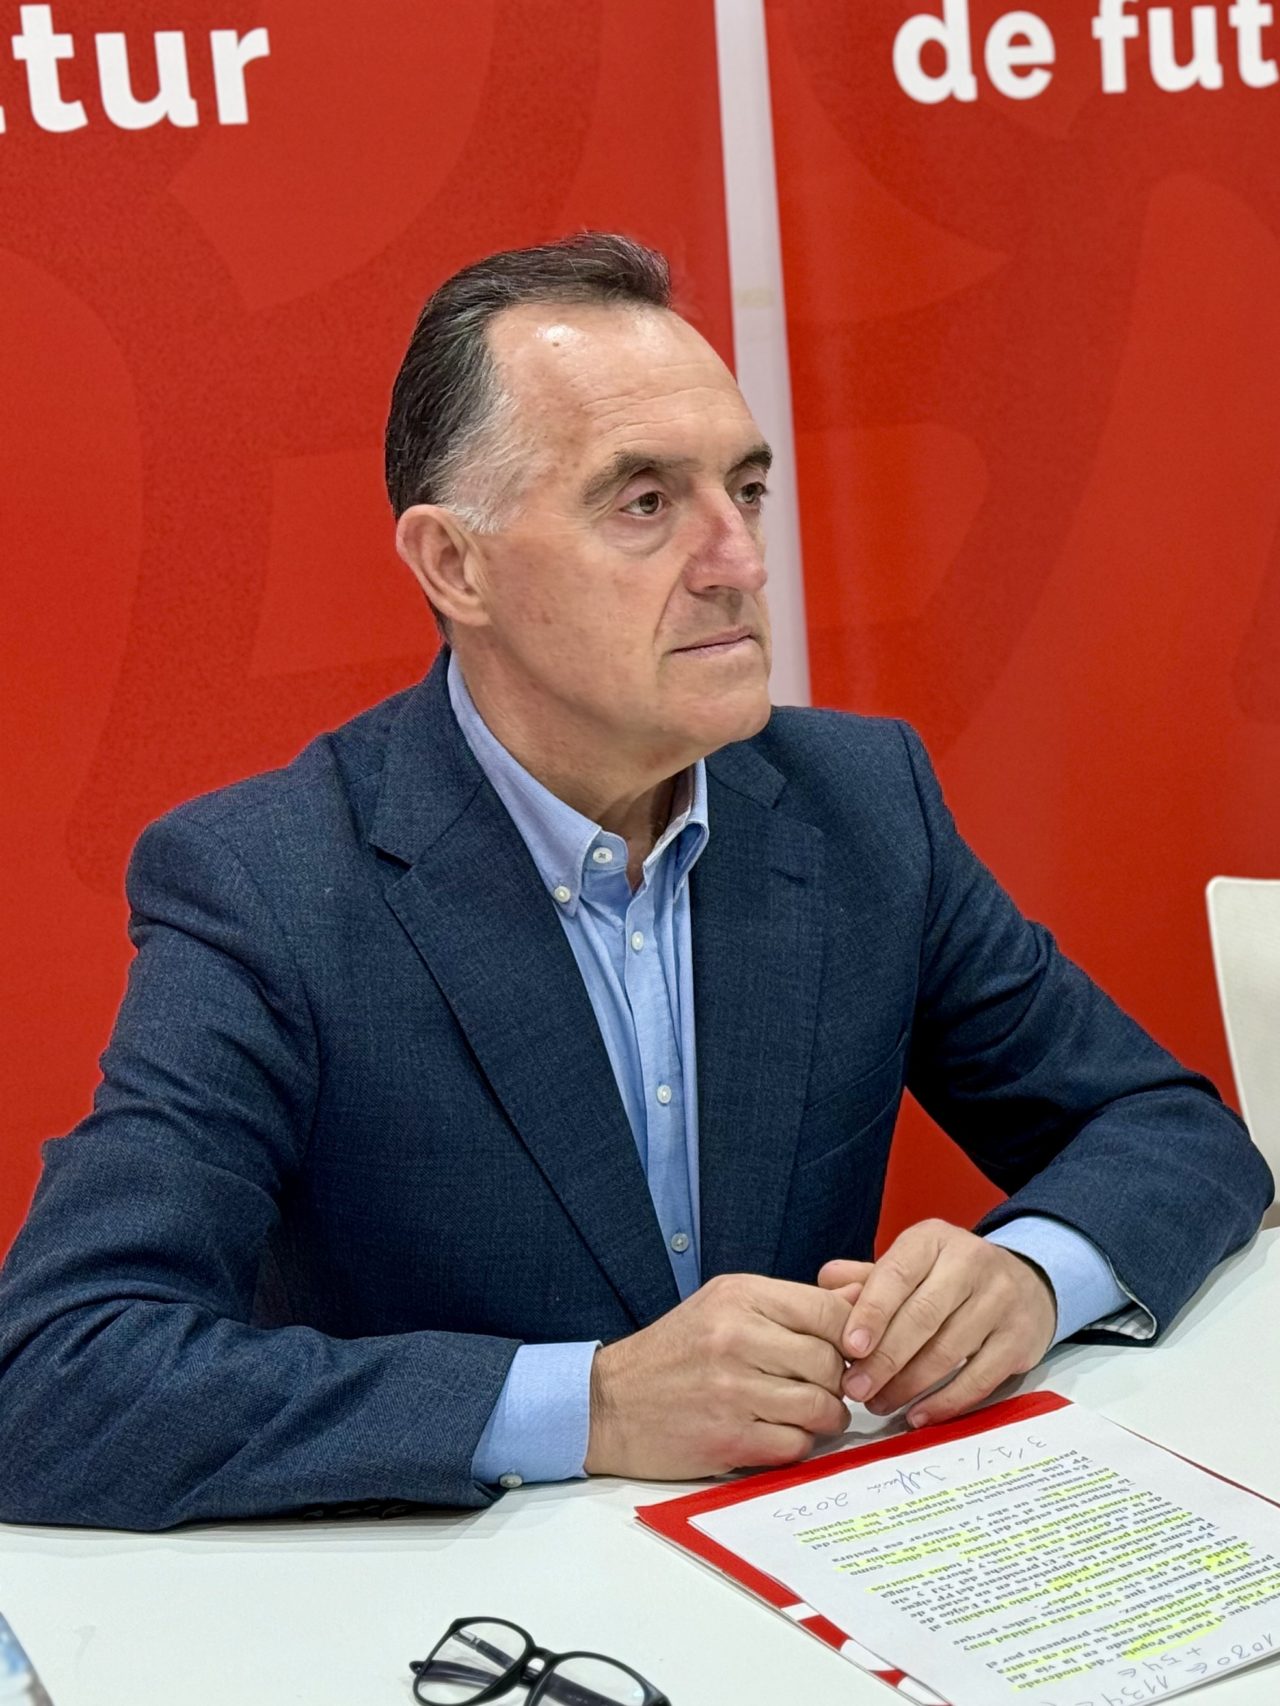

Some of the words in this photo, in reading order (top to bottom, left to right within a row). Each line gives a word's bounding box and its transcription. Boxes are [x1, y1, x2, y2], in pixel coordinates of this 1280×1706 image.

[892, 0, 1056, 104] de
[0, 4, 271, 133] tur
[1063, 1471, 1120, 1492] pensiones
[1116, 1477, 1134, 1485] lo
[1032, 1490, 1062, 1502] hace
[1039, 1482, 1113, 1508] demostraron
[1079, 1487, 1130, 1504] Siempre
[1097, 1490, 1153, 1510] fuéramos
[773, 1492, 849, 1522] 2023
[986, 1507, 1009, 1517] año
[1012, 1500, 1030, 1509] un
[1054, 1502, 1079, 1512] han
[987, 1513, 1019, 1526] votar
[1013, 1510, 1052, 1526] estado
[1041, 1507, 1096, 1529] culpables
[1064, 1506, 1128, 1530] ciudadanía
[1132, 1506, 1183, 1525] teniendo
[1132, 1511, 1192, 1534] crispación
[991, 1524, 1012, 1534] del
[1066, 1520, 1112, 1539] derrota
[1169, 1516, 1205, 1532] haber
[1197, 1522, 1219, 1532] PP
[909, 1525, 955, 1542] reiterar
[921, 1532, 962, 1547] contra
[963, 1531, 992, 1543] lado
[1028, 1528, 1061, 1543] como
[1069, 1523, 1128, 1546] pesadillas
[1110, 1529, 1166, 1551] instalado
[1159, 1529, 1193, 1543] como
[1213, 1534, 1238, 1547] está
[883, 1540, 904, 1549] esa
[924, 1545, 944, 1554] las
[977, 1545, 1011, 1559] todas
[1029, 1542, 1049, 1551] las
[1041, 1545, 1065, 1556] con
[1135, 1541, 1184, 1562] decisión
[1204, 1540, 1252, 1559] alejada
[831, 1546, 879, 1562] postura
[865, 1551, 896, 1563] subir
[1077, 1553, 1097, 1562] los
[1092, 1541, 1157, 1567] alternativa
[1170, 1543, 1213, 1562] cegado
[1233, 1550, 1251, 1560] El
[839, 1560, 860, 1569] las
[849, 1563, 884, 1575] como
[927, 1561, 963, 1574] todos
[982, 1561, 1020, 1576] noche
[1212, 1553, 1274, 1580] presidente
[1216, 1557, 1234, 1567] PP
[936, 1566, 974, 1581] ahora
[976, 1562, 1040, 1587] presidente
[1013, 1559, 1075, 1584] populares
[1043, 1564, 1090, 1584] política
[1075, 1566, 1115, 1583] contra
[1093, 1565, 1154, 1590] fanatismo
[1144, 1570, 1168, 1581] que
[1148, 1564, 1212, 1590] demuestra
[1222, 1564, 1271, 1586] paquete
[870, 1572, 925, 1592] nosotros
[957, 1575, 978, 1585] del
[1053, 1581, 1073, 1592] del
[1115, 1580, 1142, 1592] vive
[1174, 1577, 1212, 1594] Pedro
[879, 1584, 919, 1598] venga
[954, 1584, 975, 1595] del
[973, 1589, 991, 1597] un
[993, 1585, 1030, 1600] acusa
[1008, 1587, 1051, 1605] pueblo
[1123, 1588, 1146, 1599] que
[890, 1596, 914, 1605] sin
[899, 1598, 932, 1611] sigue
[929, 1595, 970, 1612] estado
[936, 1592, 955, 1604] PP
[1095, 1598, 1122, 1610] vive
[1151, 1590, 1203, 1613] medidas
[938, 1602, 980, 1618] Feijóo
[944, 1603, 1007, 1625] inhabilita
[1040, 1597, 1093, 1617] nuestras
[1137, 1592, 1224, 1630] parlamentario
[1227, 1604, 1250, 1616] que
[1001, 1615, 1037, 1629] calles
[1049, 1613, 1075, 1624] una
[1092, 1610, 1150, 1633] anticrisis
[1179, 1609, 1212, 1624] sigue
[952, 1626, 998, 1645] porque
[994, 1622, 1047, 1643] realidad
[1105, 1623, 1173, 1650] enquistado
[1110, 1626, 1134, 1638] con
[1166, 1619, 1214, 1640] Partido
[962, 1639, 991, 1651] muy
[1027, 1629, 1091, 1654] propuesto
[1061, 1641, 1091, 1654] voto
[1115, 1637, 1166, 1658] Popular
[1002, 1650, 1025, 1663] por
[1041, 1651, 1058, 1660] en
[1061, 1656, 1078, 1664] la
[1081, 1649, 1099, 1658] en
[995, 1658, 1039, 1674] contra
[1033, 1664, 1056, 1673] vía
[1005, 1672, 1027, 1683] del
[1017, 1665, 1083, 1689] moderado
